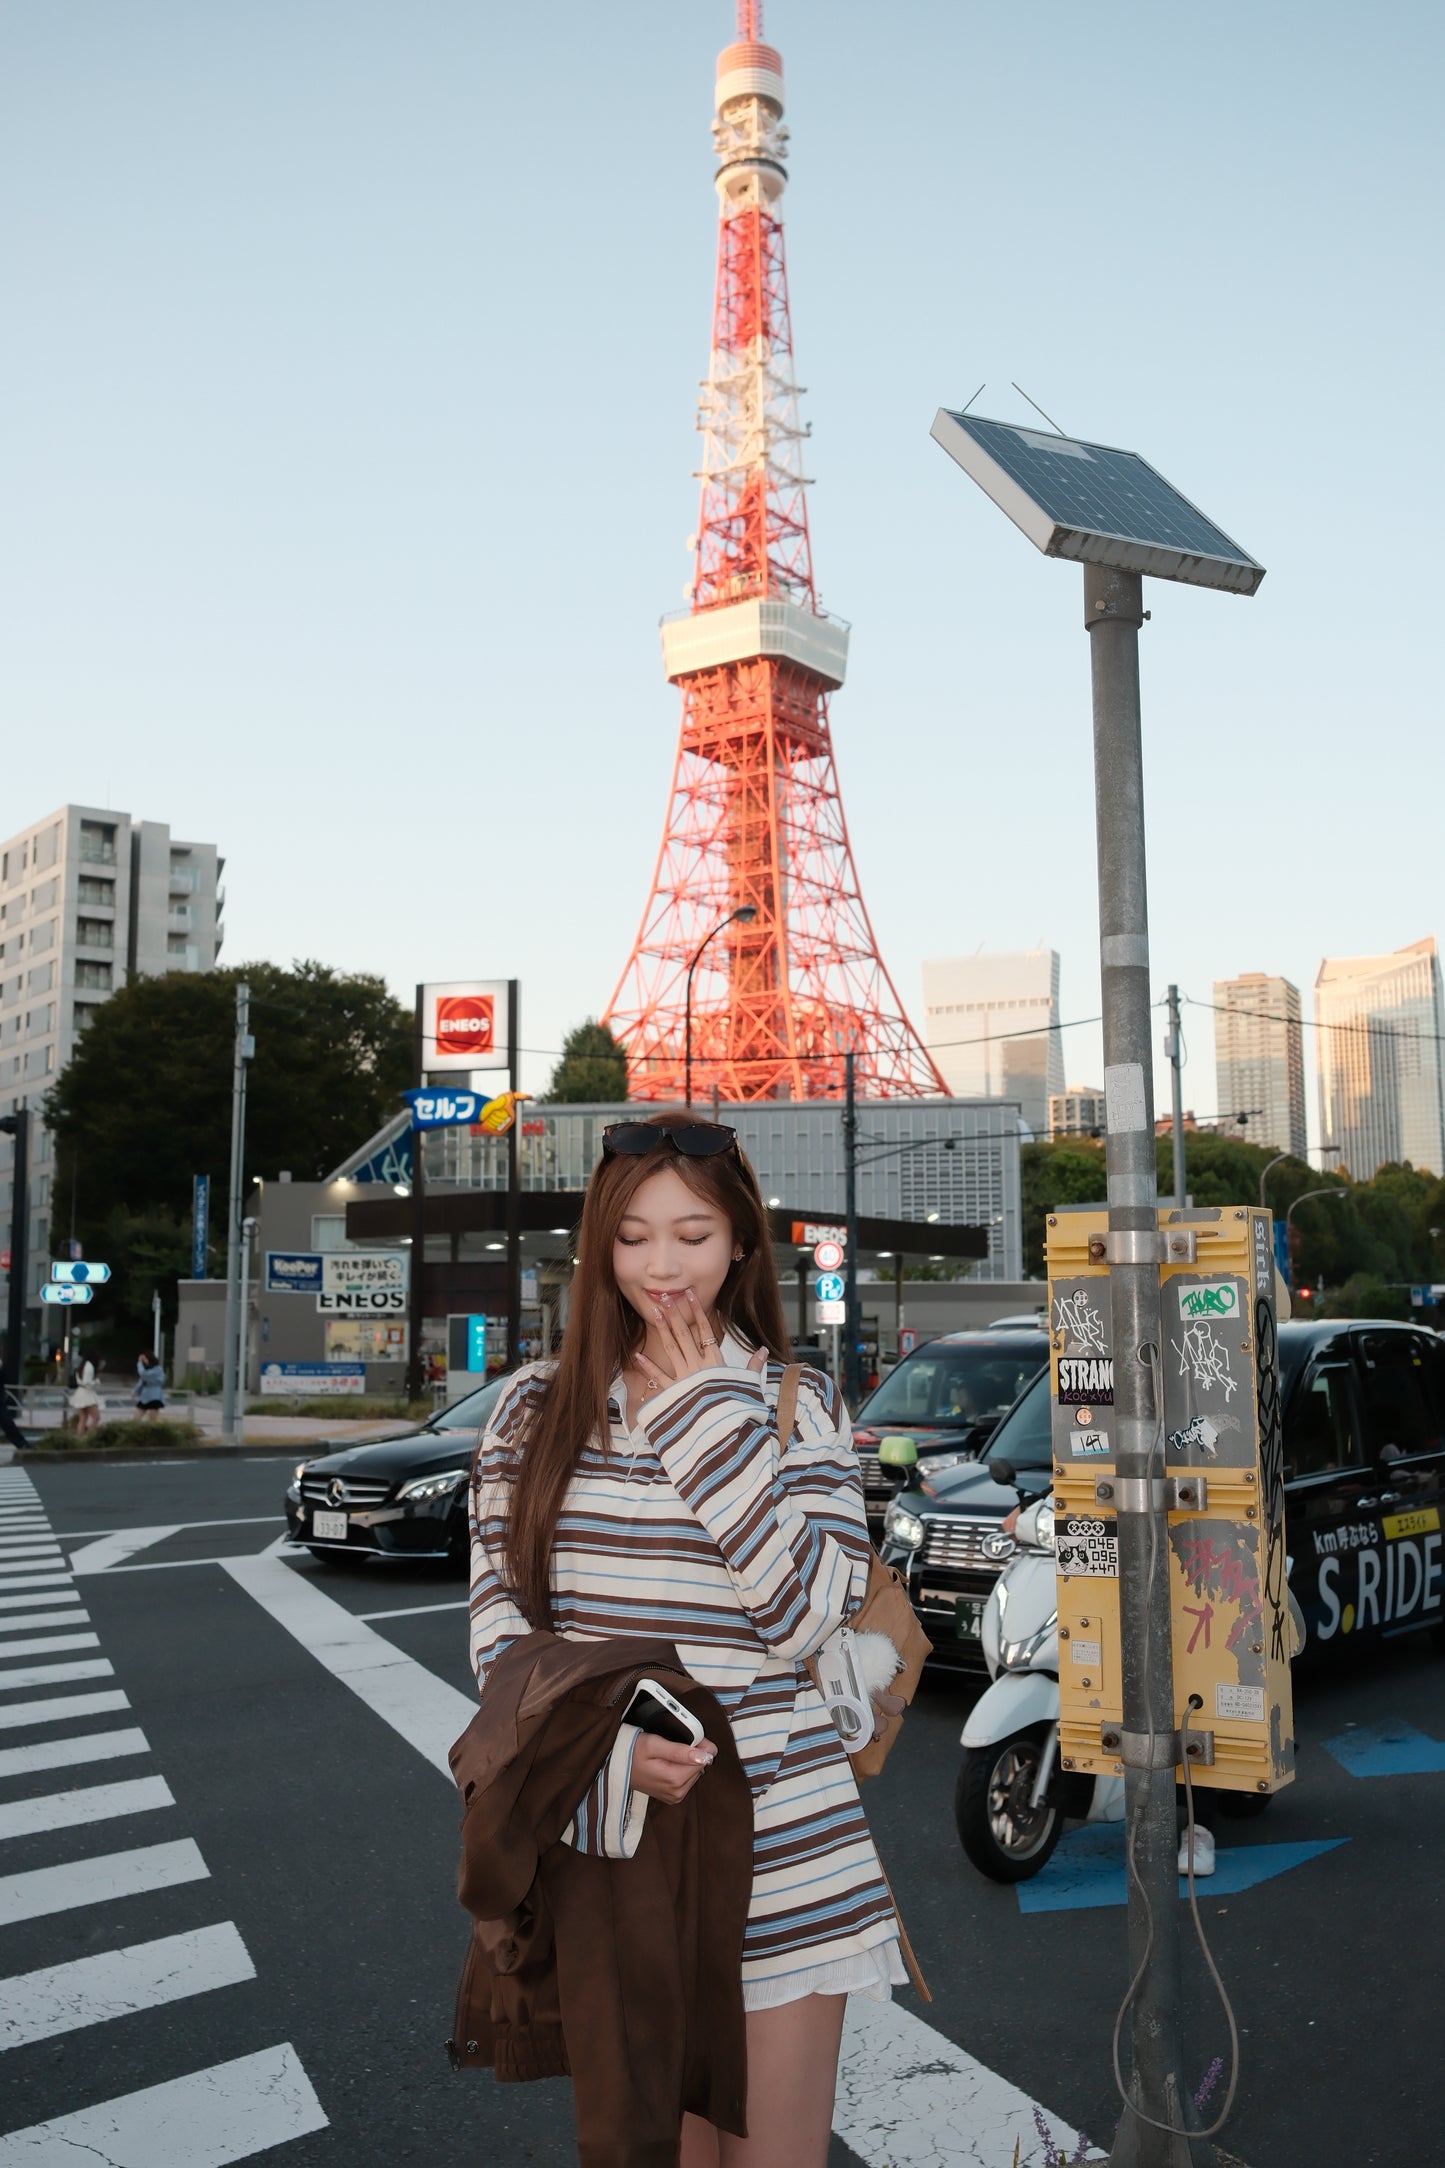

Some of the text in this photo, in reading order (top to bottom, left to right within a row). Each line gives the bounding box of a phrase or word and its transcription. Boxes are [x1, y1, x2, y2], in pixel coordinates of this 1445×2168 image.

[439, 1017, 490, 1033] ENEOS
[414, 1096, 475, 1120] セルフ
[804, 1224, 847, 1246] ENEOS
[821, 1279, 833, 1298] P
[320, 1291, 403, 1308] ENEOS
[1088, 1537, 1115, 1549] 046
[1313, 1521, 1378, 1554] km呼ぶなら
[1092, 1551, 1117, 1563] 096
[1317, 1533, 1442, 1640] S.RIDE
